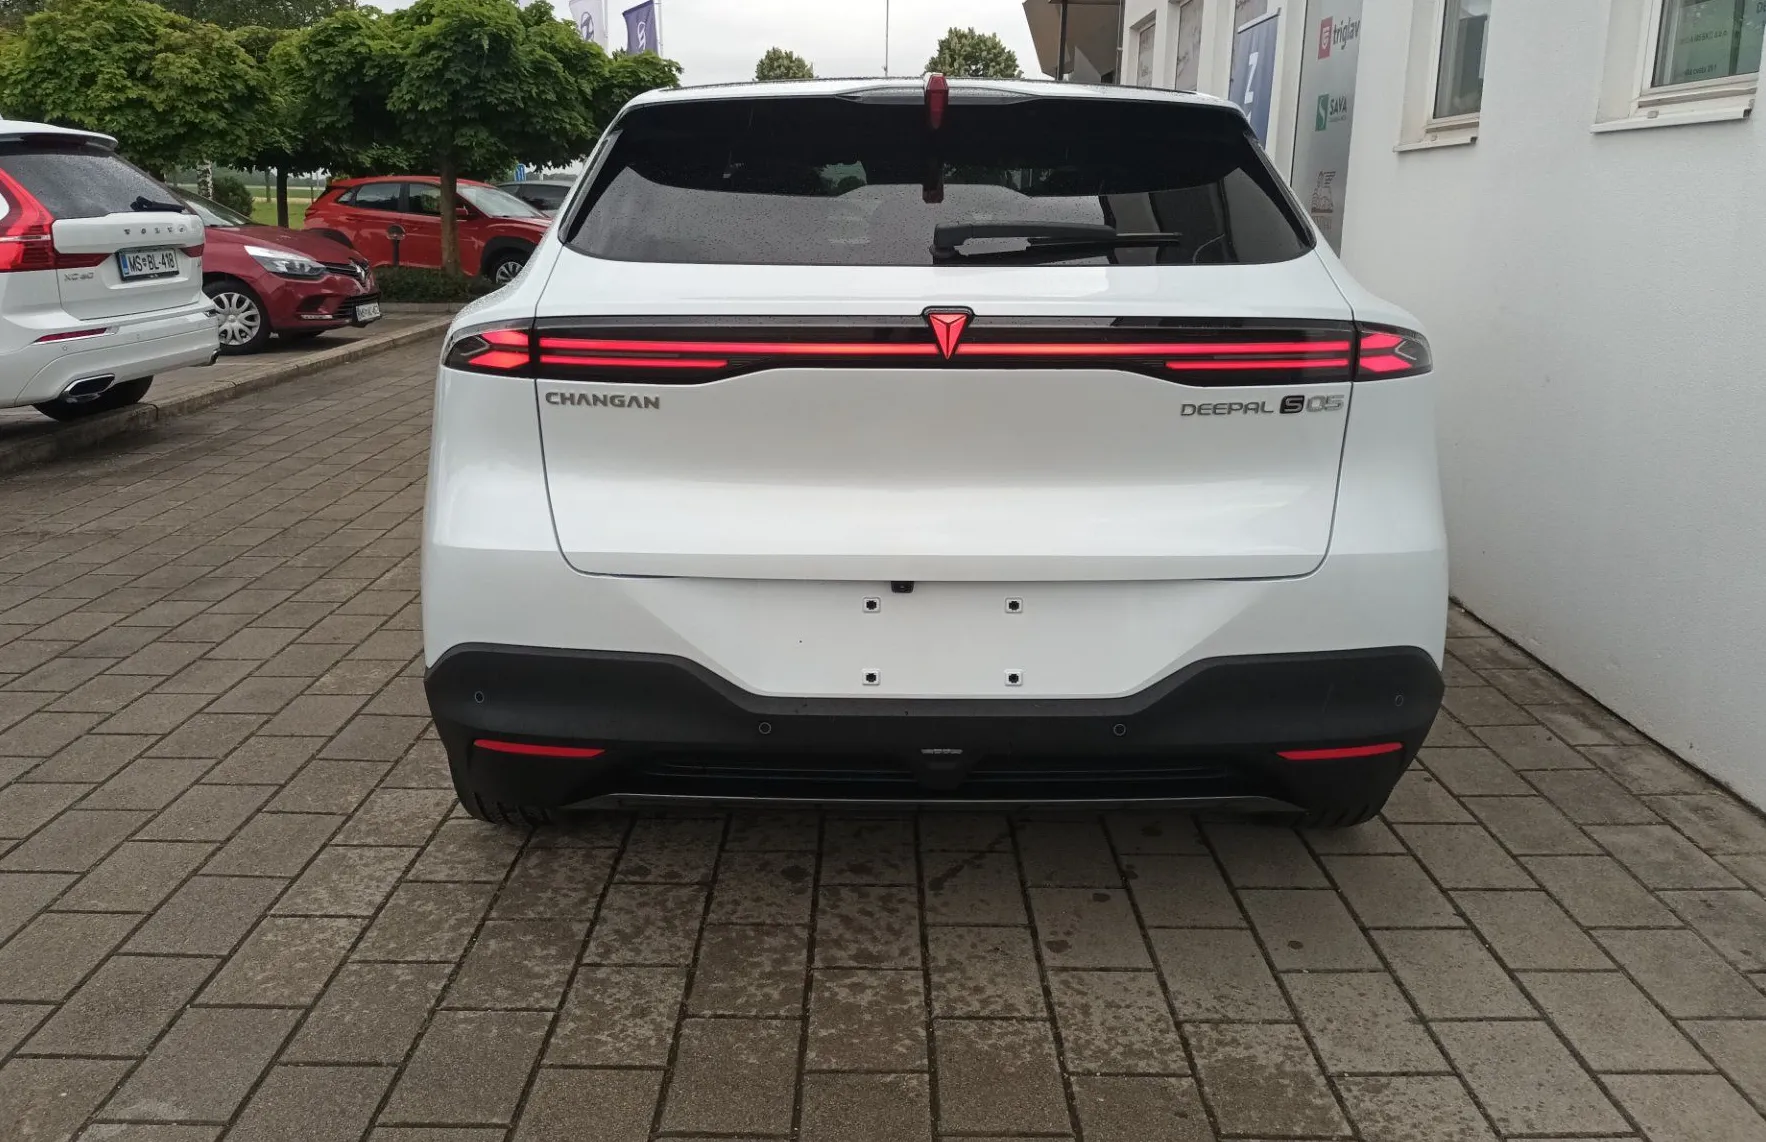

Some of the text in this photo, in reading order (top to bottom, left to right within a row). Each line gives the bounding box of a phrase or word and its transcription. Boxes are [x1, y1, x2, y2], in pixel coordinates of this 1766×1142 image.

[1333, 17, 1360, 50] triglav
[1330, 96, 1347, 115] SAVA
[128, 255, 143, 272] MS
[545, 392, 660, 409] CHANGAN
[1180, 401, 1274, 416] DEEPAL
